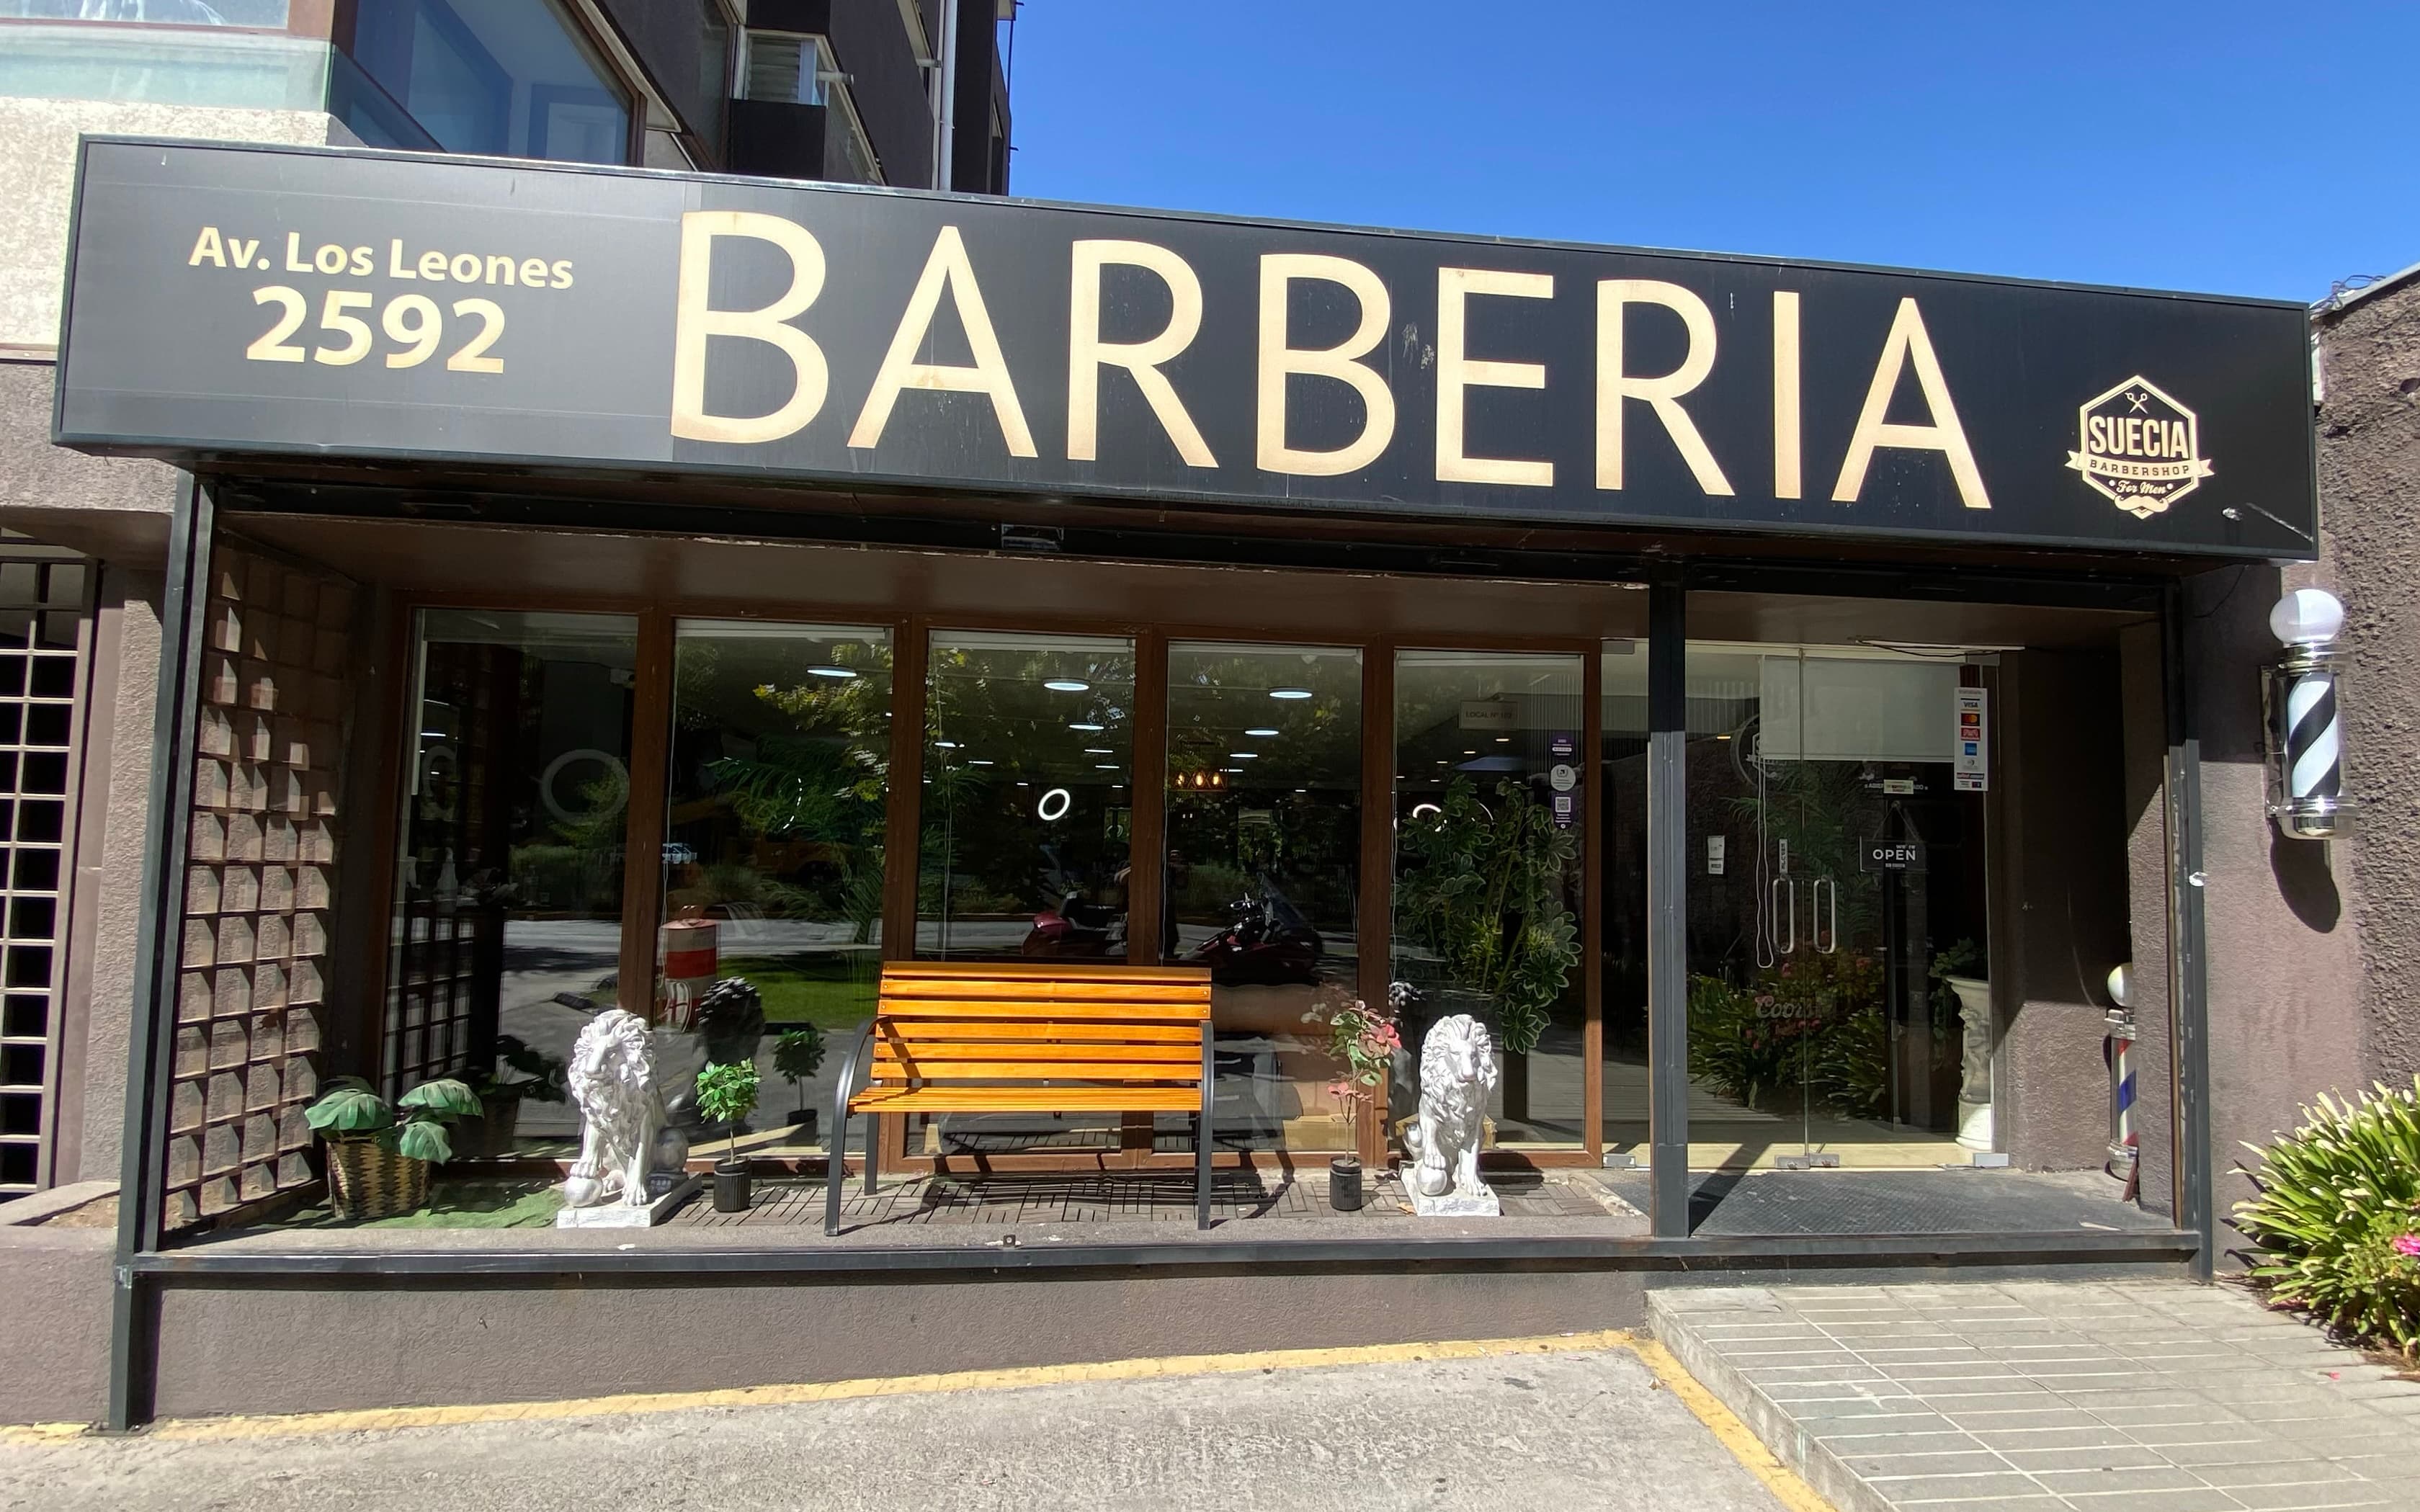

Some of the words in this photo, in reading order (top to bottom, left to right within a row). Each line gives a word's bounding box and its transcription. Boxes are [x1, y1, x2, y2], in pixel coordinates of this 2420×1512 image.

[189, 226, 269, 270] Av.
[286, 231, 375, 277] Los
[389, 238, 575, 290] Leones
[246, 285, 506, 374] 2592
[670, 210, 1993, 510] BARBERIA
[2089, 416, 2189, 460] SUECIA
[2089, 459, 2191, 477] BARBERSHOP
[2116, 480, 2138, 493] For
[2140, 480, 2167, 495] Men
[1465, 710, 1489, 719] LOCAL
[1872, 849, 1916, 861] OPEN
